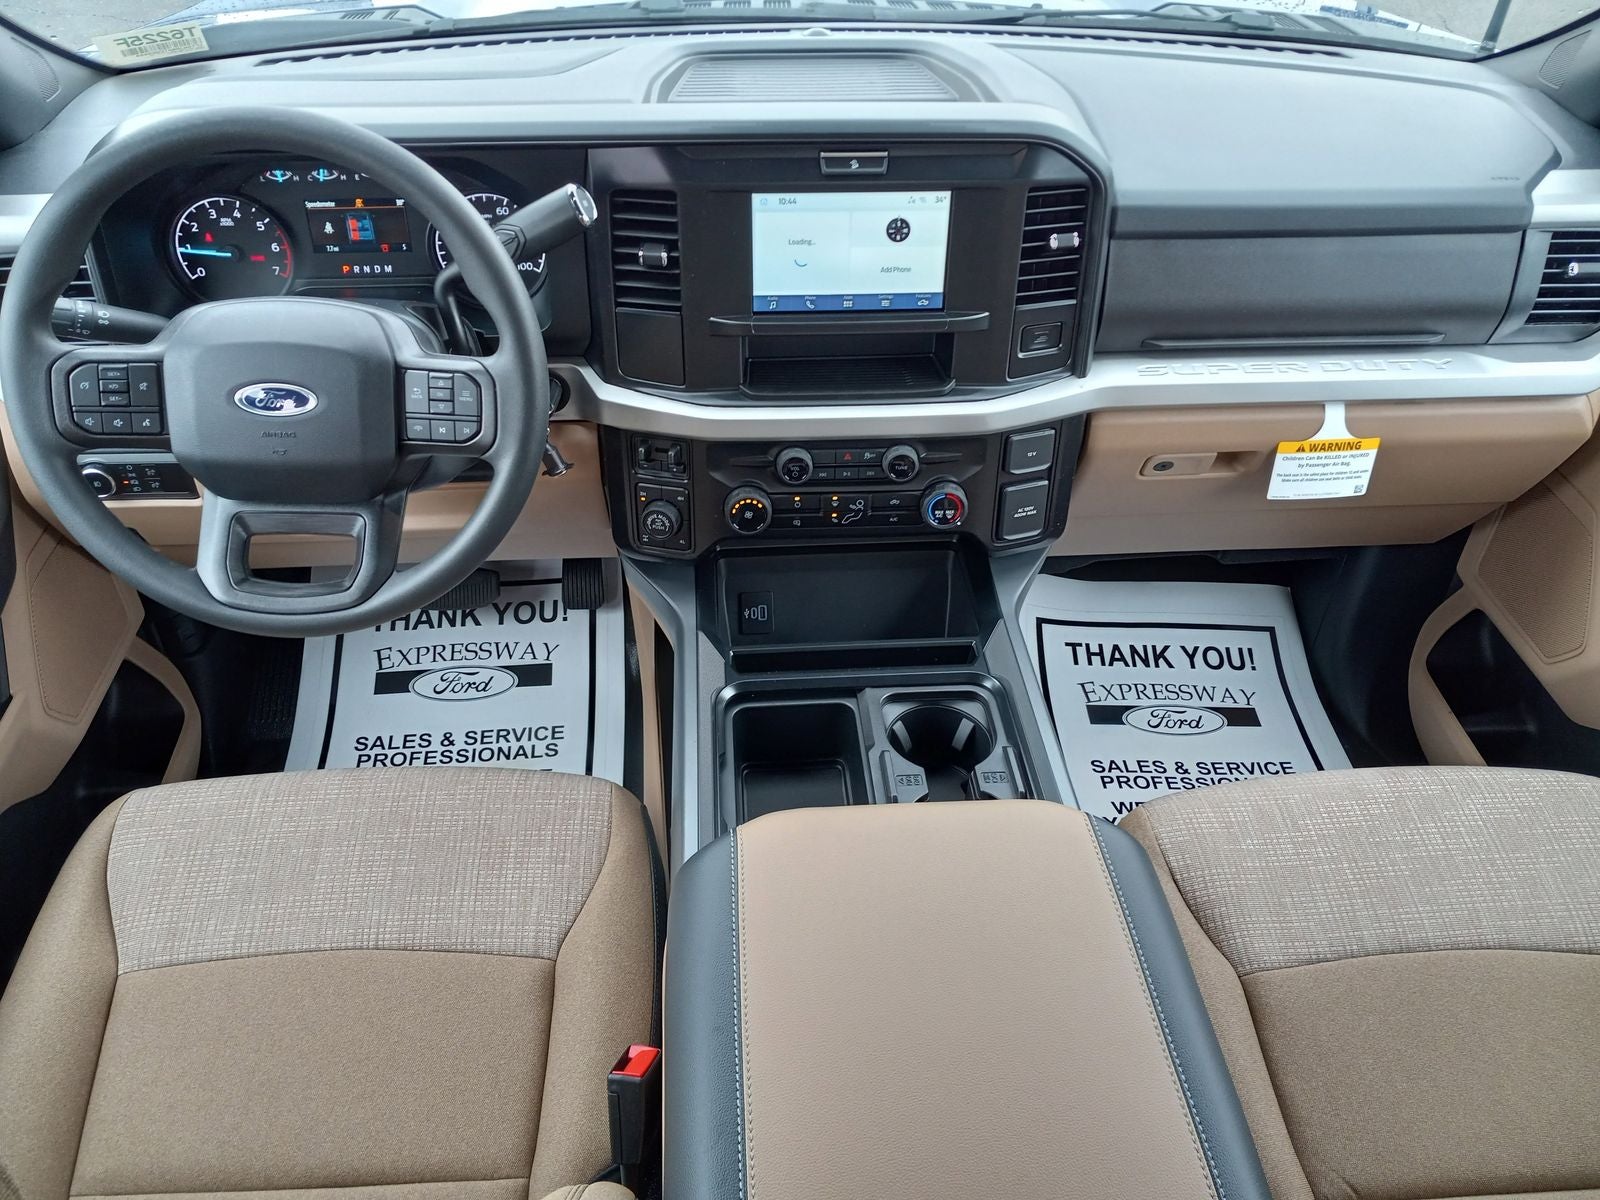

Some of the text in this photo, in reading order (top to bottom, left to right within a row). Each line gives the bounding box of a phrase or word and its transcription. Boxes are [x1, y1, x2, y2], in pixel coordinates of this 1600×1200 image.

[778, 197, 797, 205] 10:44
[208, 209, 218, 219] 3
[233, 208, 242, 219] 4
[496, 206, 509, 216] 60
[190, 222, 199, 233] 2
[256, 221, 265, 231] 5
[271, 242, 280, 252] 6
[197, 267, 206, 277] 0
[271, 266, 280, 276] 7
[342, 265, 392, 273] P R N D M
[880, 266, 893, 274] Add
[1136, 358, 1453, 377] SUPER DUTY
[254, 389, 297, 409] Ford
[1309, 441, 1362, 453] WARNING
[375, 600, 569, 633] HANK YOU!
[372, 641, 560, 672] EXPRESSWAY
[1064, 642, 1258, 672] THANK YOU!
[433, 670, 494, 696] Ford
[1077, 681, 1257, 706] EXPRESSWAY
[1147, 708, 1206, 730] Ford
[353, 725, 566, 752] SALES & SERVICE
[355, 742, 560, 770] PROFESSIONALS
[1090, 759, 1297, 776] SALES & SERVICE
